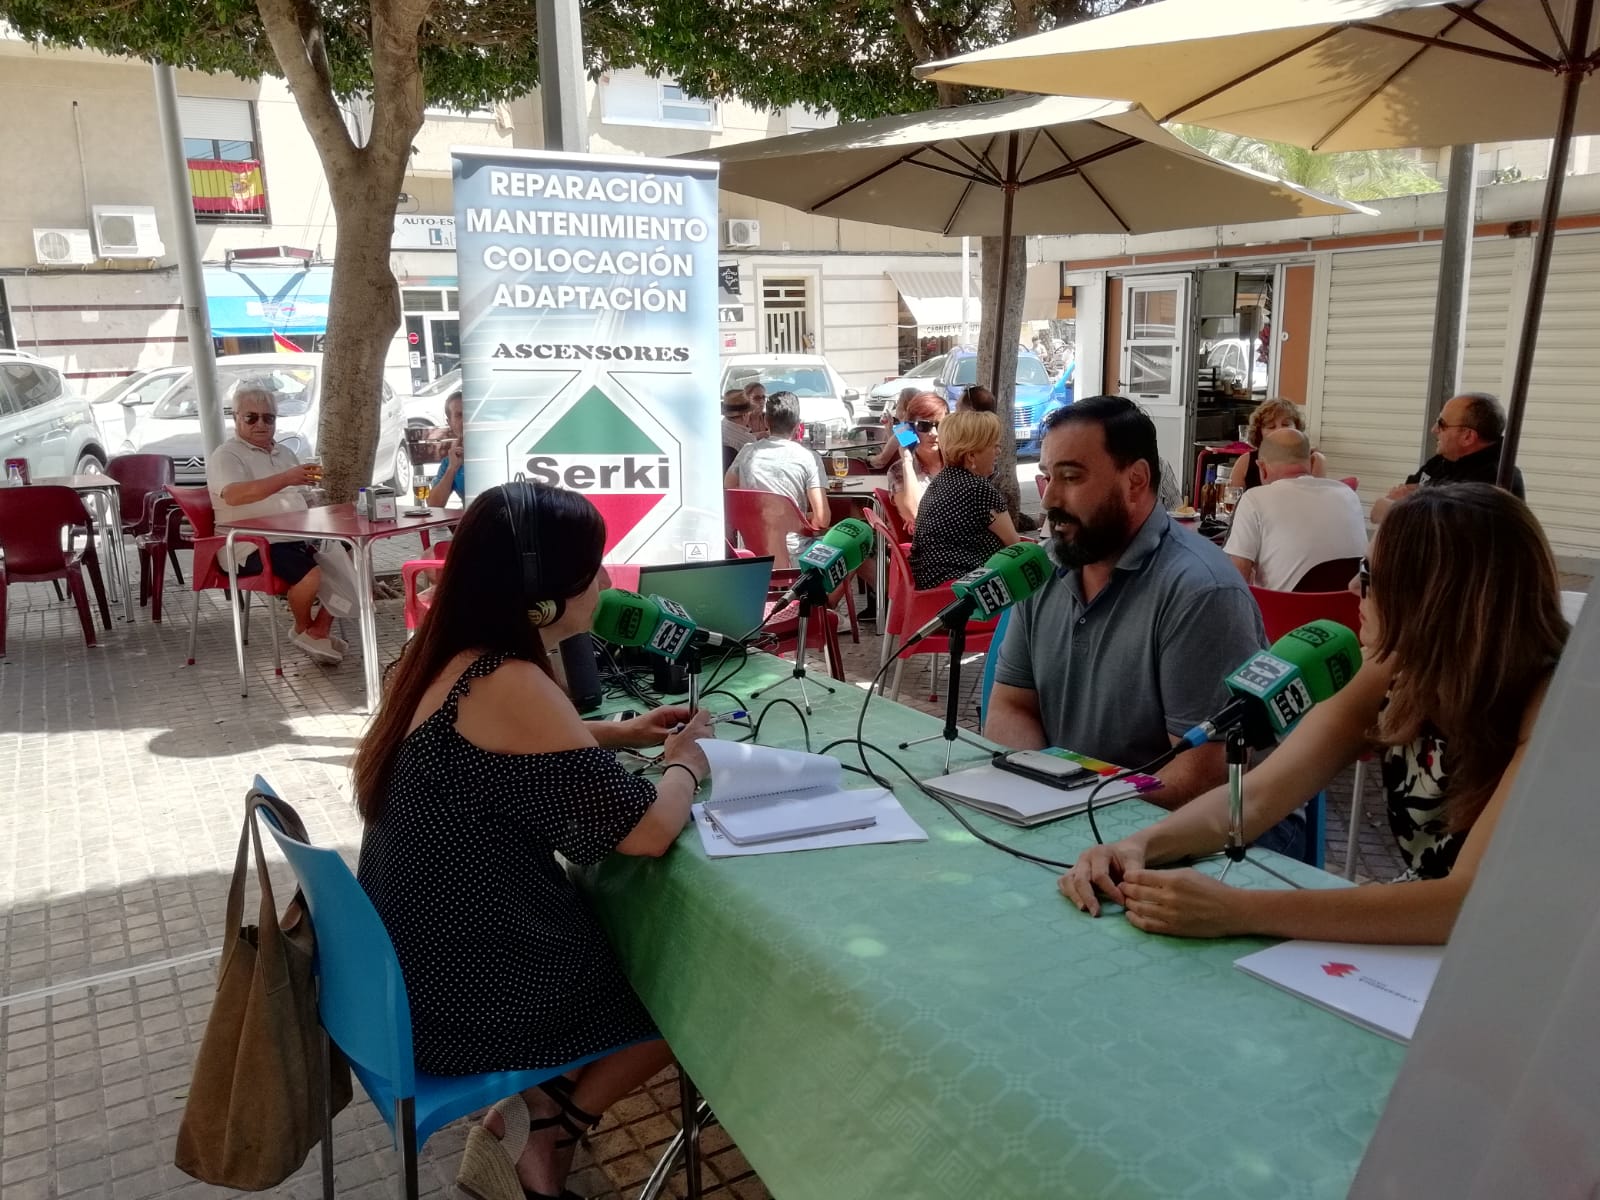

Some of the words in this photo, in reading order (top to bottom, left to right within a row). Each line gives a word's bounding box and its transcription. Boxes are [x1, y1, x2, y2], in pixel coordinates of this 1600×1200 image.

[491, 171, 683, 206] REPARACIÓN
[467, 208, 708, 242] MANTENIMIENTO
[484, 245, 693, 277] COLOCACIÓN
[493, 282, 687, 312] ADAPTACIÓN
[491, 343, 690, 362] ASCENSORES
[525, 456, 670, 489] Serki
[1276, 693, 1293, 721] CERO
